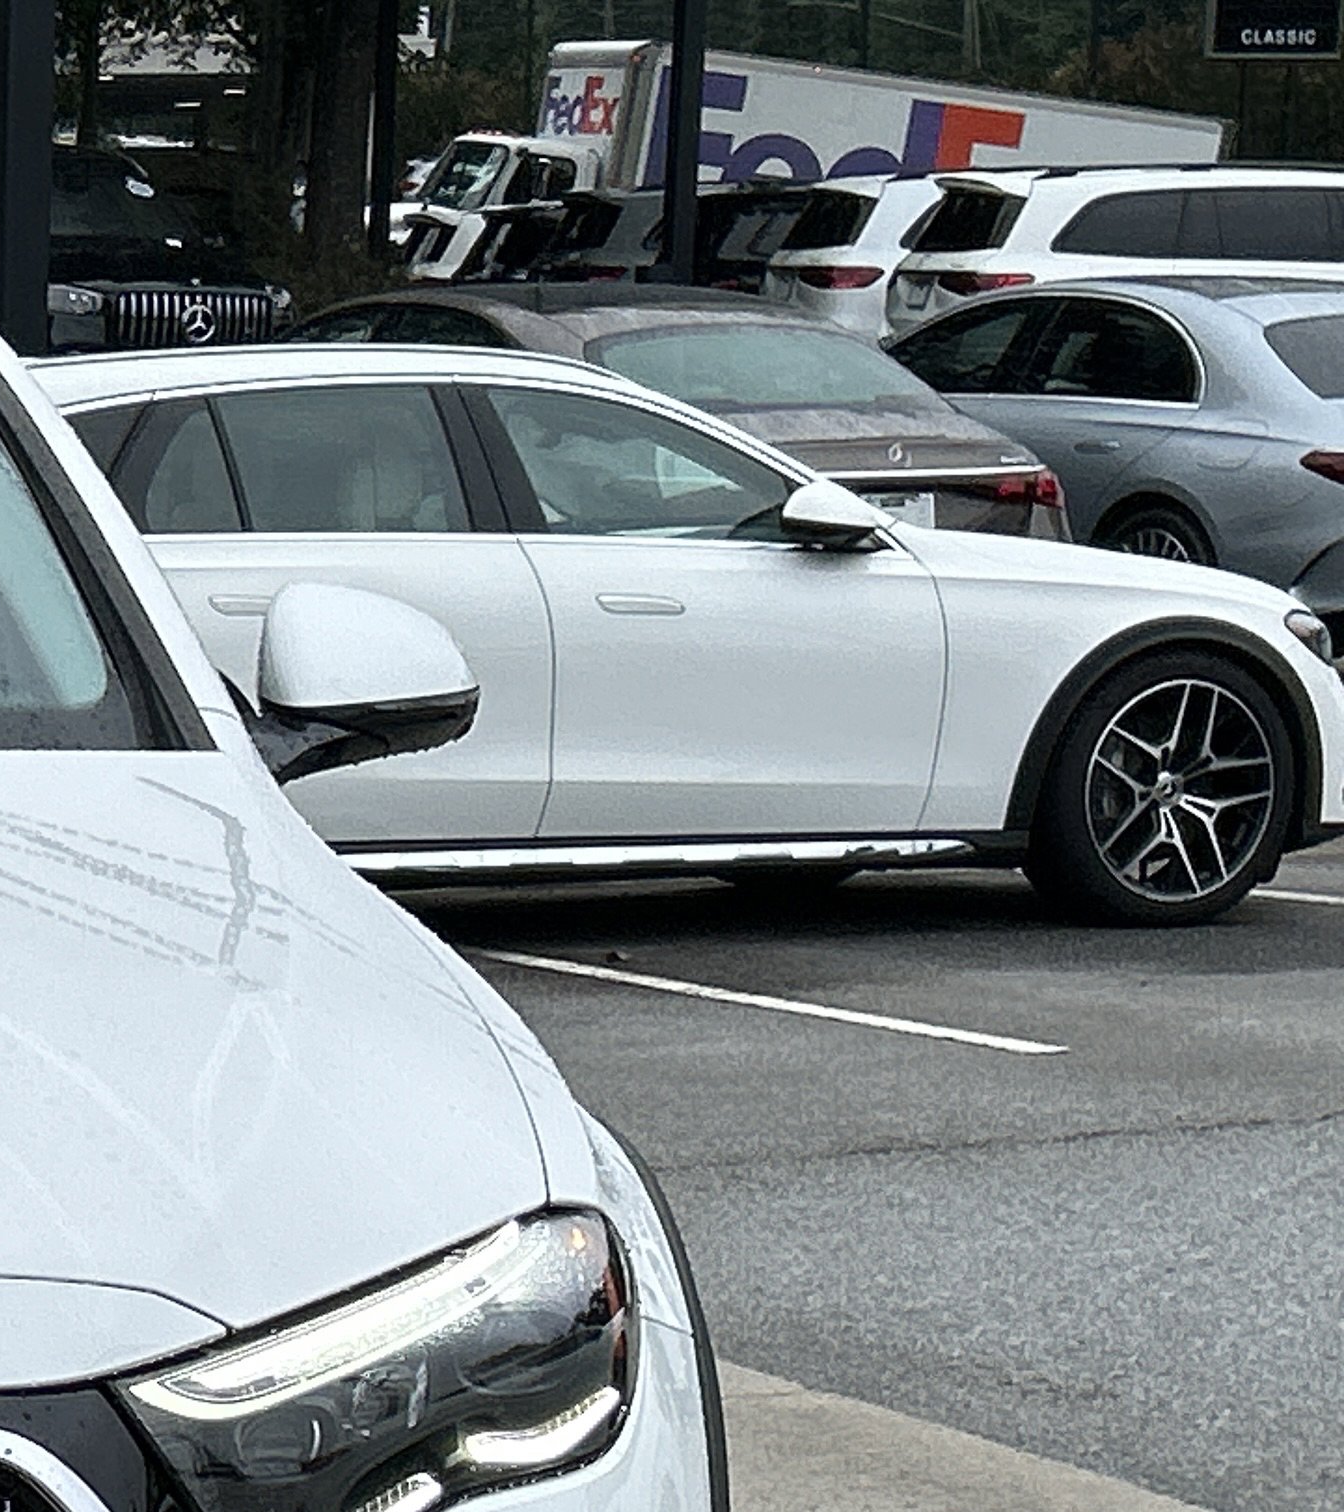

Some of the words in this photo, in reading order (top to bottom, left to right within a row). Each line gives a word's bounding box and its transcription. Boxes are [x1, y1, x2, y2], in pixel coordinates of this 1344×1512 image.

[1240, 28, 1317, 45] CLASSIC
[540, 76, 620, 135] FedEx
[641, 66, 1027, 188] FedE
